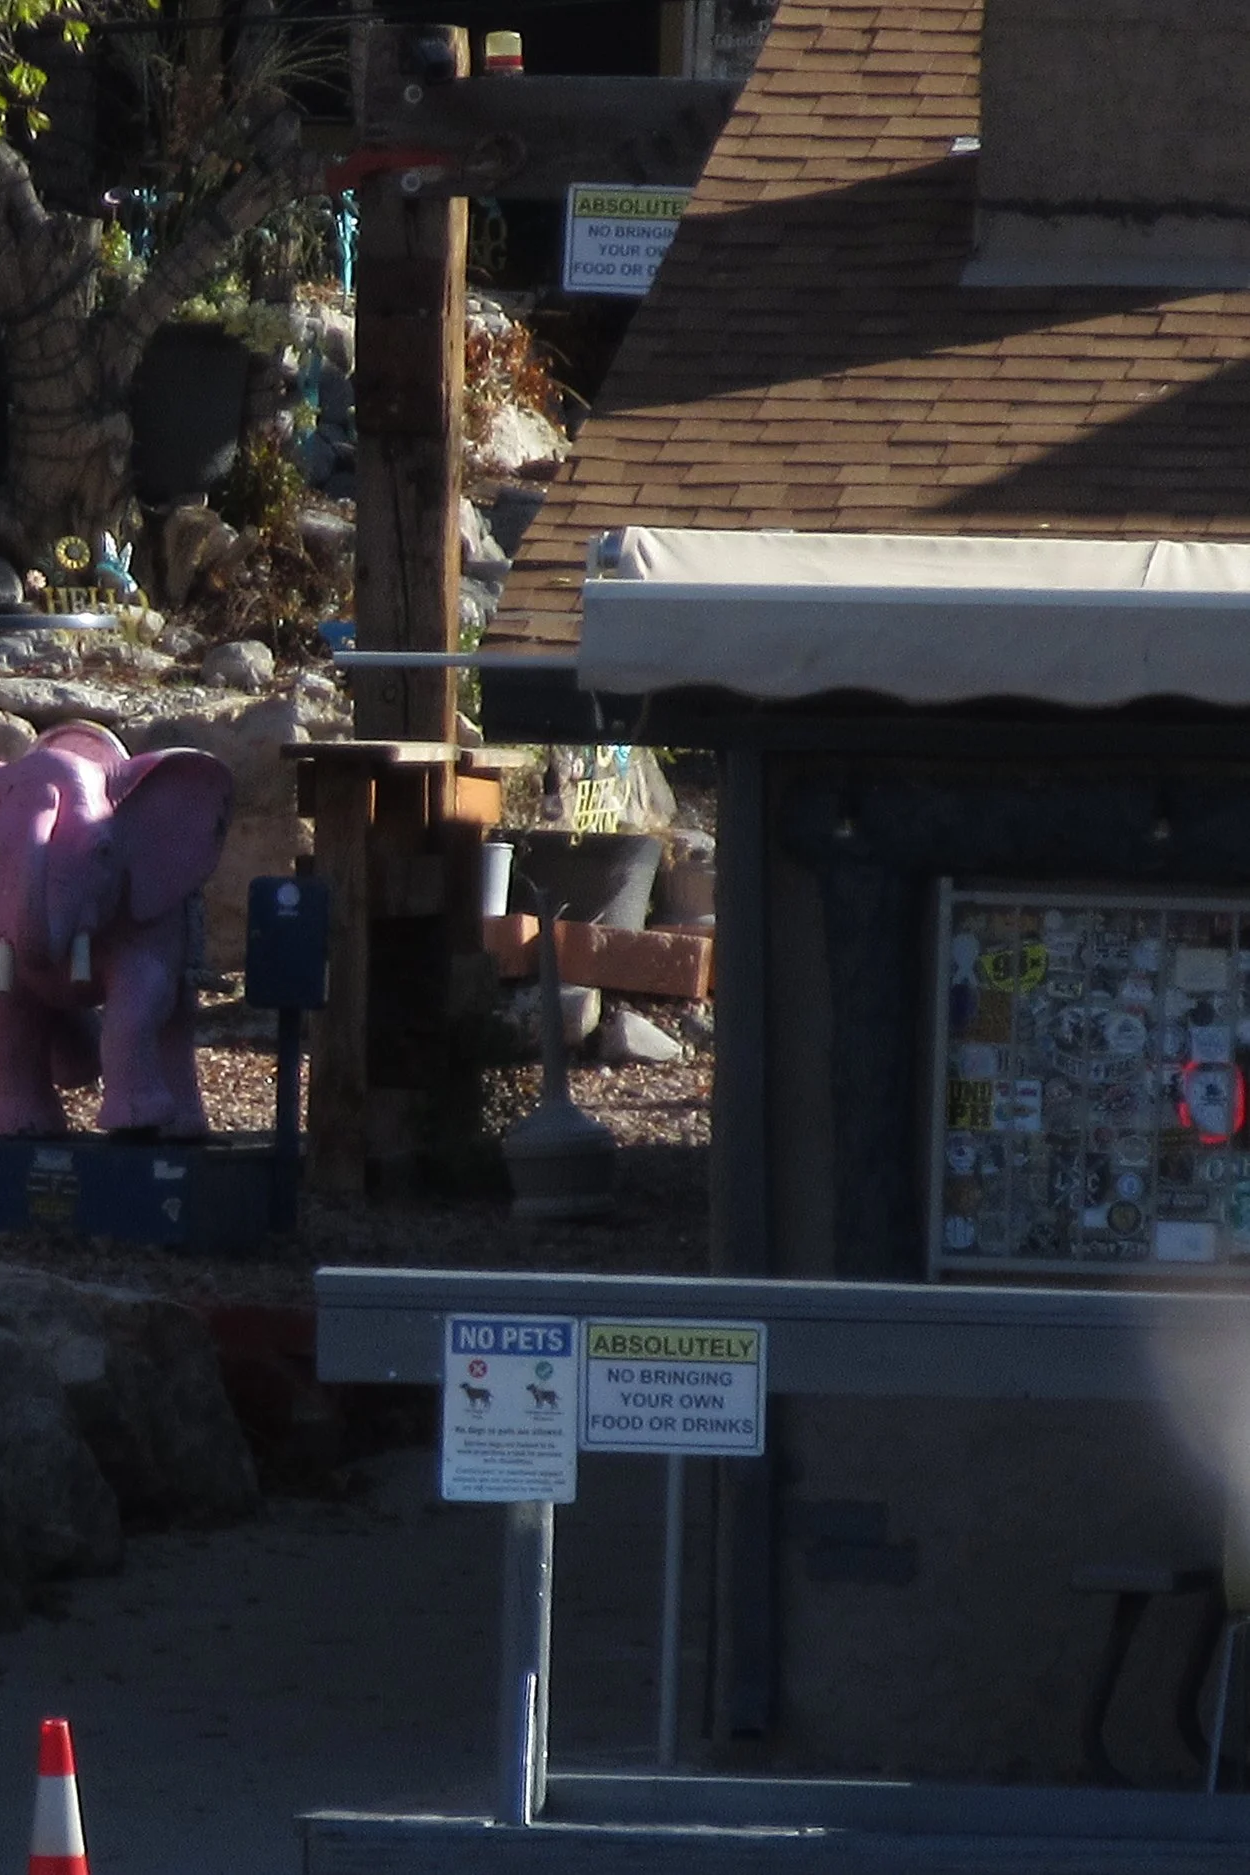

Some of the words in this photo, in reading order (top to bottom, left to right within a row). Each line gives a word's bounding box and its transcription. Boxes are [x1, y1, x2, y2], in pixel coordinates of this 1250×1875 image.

[579, 198, 689, 216] ABSOLUTE
[588, 225, 611, 238] NO
[598, 243, 641, 257] YOUR
[574, 261, 616, 276] FOOD
[620, 263, 642, 276] OR
[458, 1325, 496, 1350] NO
[501, 1326, 565, 1352] PETS
[593, 1335, 754, 1358] ABSOLUTELY
[607, 1367, 635, 1384] NO
[640, 1369, 733, 1387] BRINGING
[620, 1392, 675, 1409] YOUR
[679, 1394, 725, 1410] OWN
[591, 1415, 644, 1431] FOOD
[649, 1416, 677, 1433] OR
[682, 1417, 754, 1435] DRINKS
